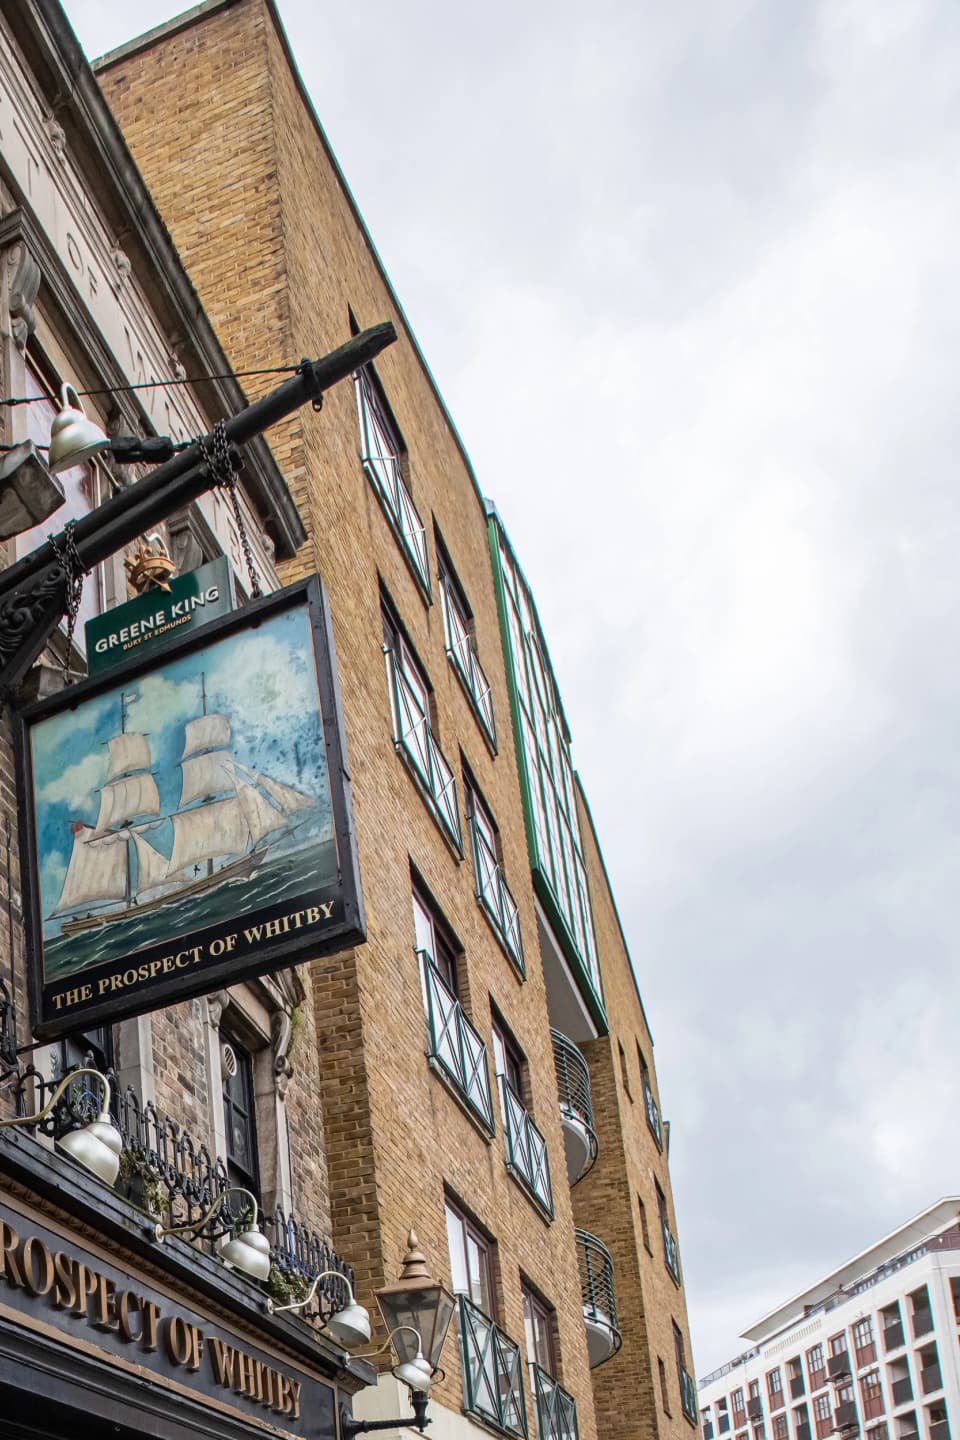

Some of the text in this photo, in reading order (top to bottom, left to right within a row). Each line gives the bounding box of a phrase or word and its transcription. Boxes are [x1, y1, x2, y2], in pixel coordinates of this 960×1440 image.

[95, 585, 220, 653] GREENE KING
[122, 614, 192, 650] BURY ST EDMUNDS
[52, 900, 336, 1010] THE PROSPECT OF WHITBY
[166, 1316, 204, 1371] OF
[208, 1337, 301, 1420] WHITBY
